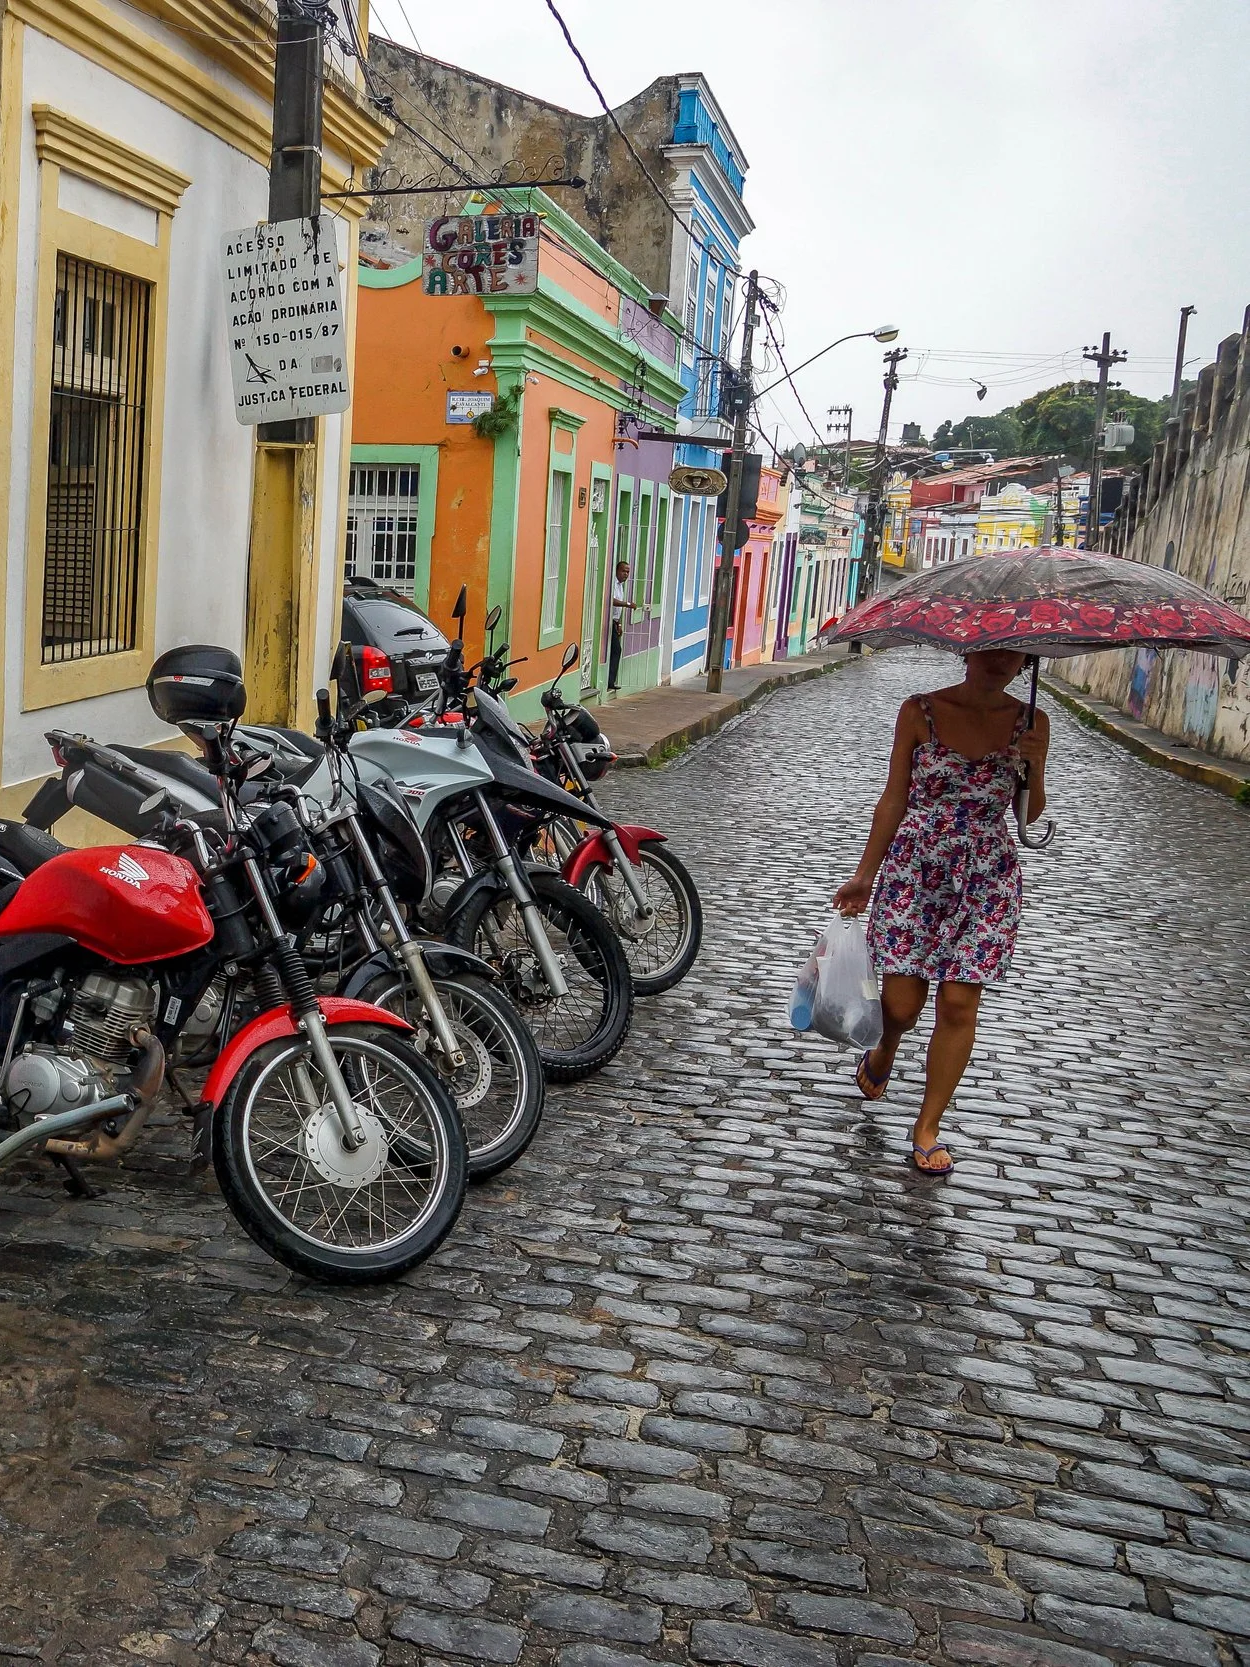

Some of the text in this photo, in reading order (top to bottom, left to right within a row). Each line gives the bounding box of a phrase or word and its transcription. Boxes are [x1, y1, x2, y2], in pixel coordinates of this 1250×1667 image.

[227, 235, 285, 256] ACESSO
[430, 217, 535, 252] GALERIA
[228, 252, 332, 280] LIMITADO DE
[442, 239, 524, 273] CORES
[230, 276, 335, 303] ACORDO COM A
[428, 265, 509, 294] ARTE
[271, 300, 338, 321] ORDINÁRIA
[256, 322, 339, 347] 150-015/87
[279, 358, 298, 372] DA
[290, 381, 347, 400] FEDERAL
[99, 866, 141, 889] HONDA
